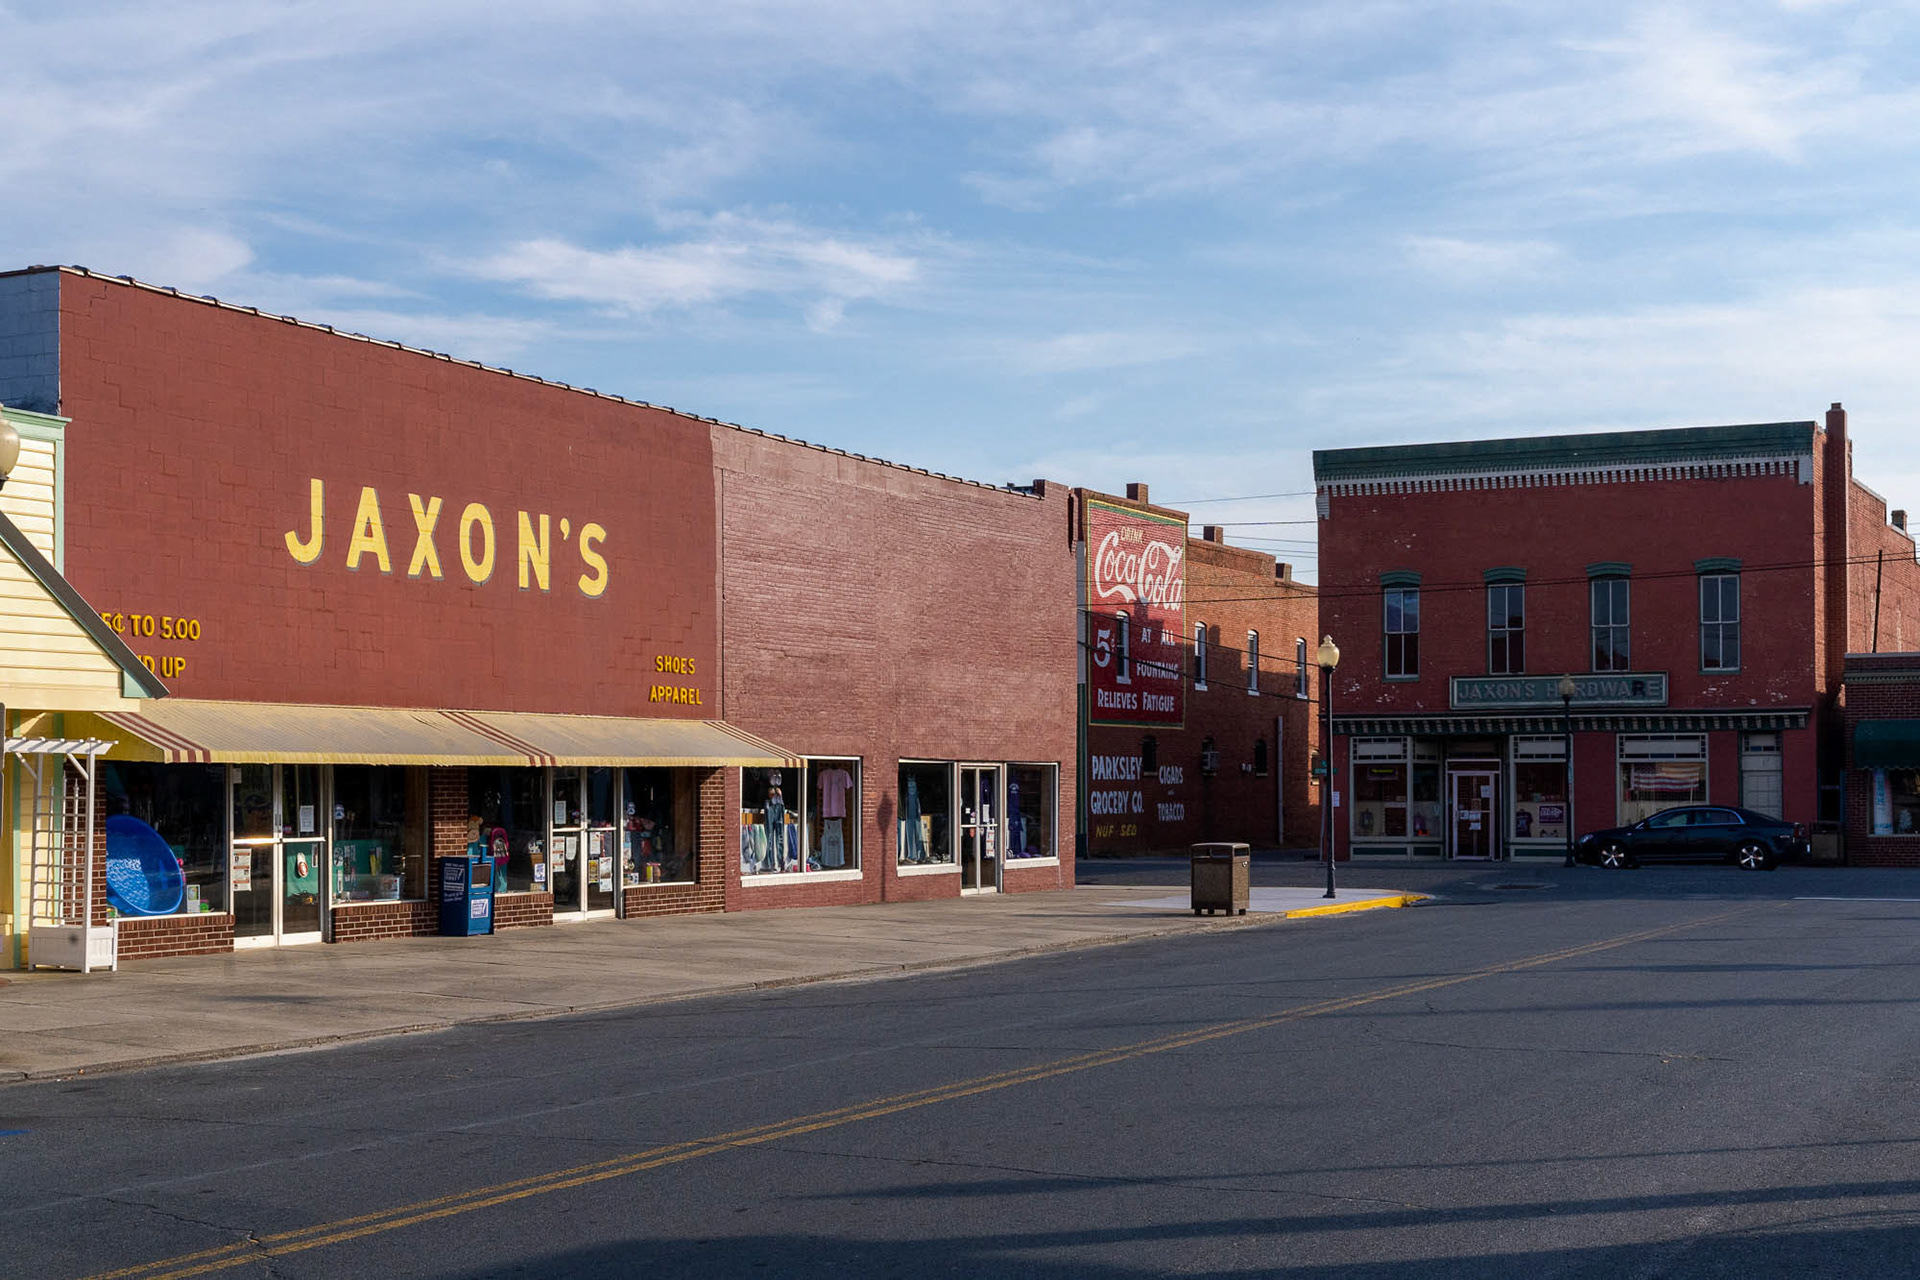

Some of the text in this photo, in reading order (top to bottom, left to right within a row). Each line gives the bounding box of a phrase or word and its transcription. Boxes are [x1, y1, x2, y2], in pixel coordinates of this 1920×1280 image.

[284, 478, 609, 598] JAXON'S
[1120, 526, 1144, 544] DRINK
[128, 614, 155, 636] TO
[160, 616, 201, 640] 5.00
[1141, 627, 1176, 646] AT ALL
[160, 656, 186, 678] UP
[655, 655, 696, 675] SHOES
[1136, 660, 1179, 680] FOUNTAINS
[648, 685, 703, 705] APPAREL
[1458, 679, 1661, 700] JAXON'S HRDWARE
[1097, 688, 1175, 712] RELIEVES FATIGUE
[1091, 755, 1143, 780] PARKSLEY
[1158, 766, 1183, 784] CIGARS
[1090, 790, 1144, 814] GROCERY CO.
[1157, 803, 1185, 821] TOBACCO
[1095, 824, 1114, 838] NUF
